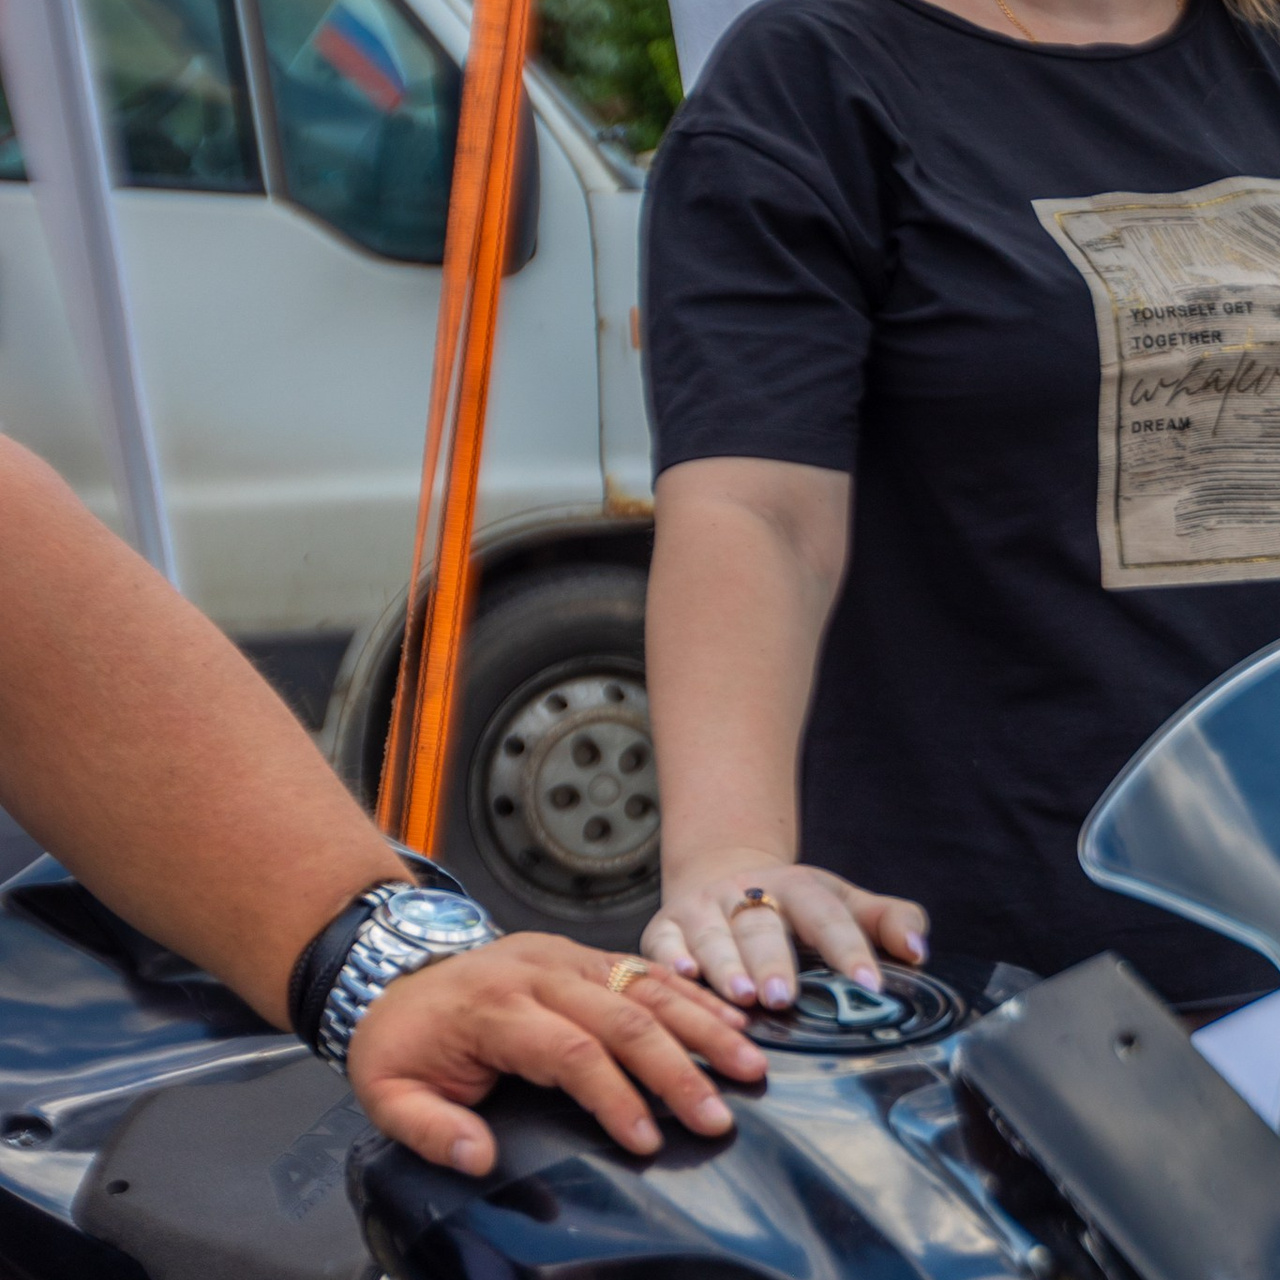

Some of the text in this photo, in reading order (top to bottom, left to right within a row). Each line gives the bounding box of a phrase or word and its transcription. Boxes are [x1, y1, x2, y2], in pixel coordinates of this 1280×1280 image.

[1130, 300, 1254, 321] YOURSELF GET
[1131, 330, 1223, 351] TOGETHER
[1131, 417, 1192, 435] DREAM
